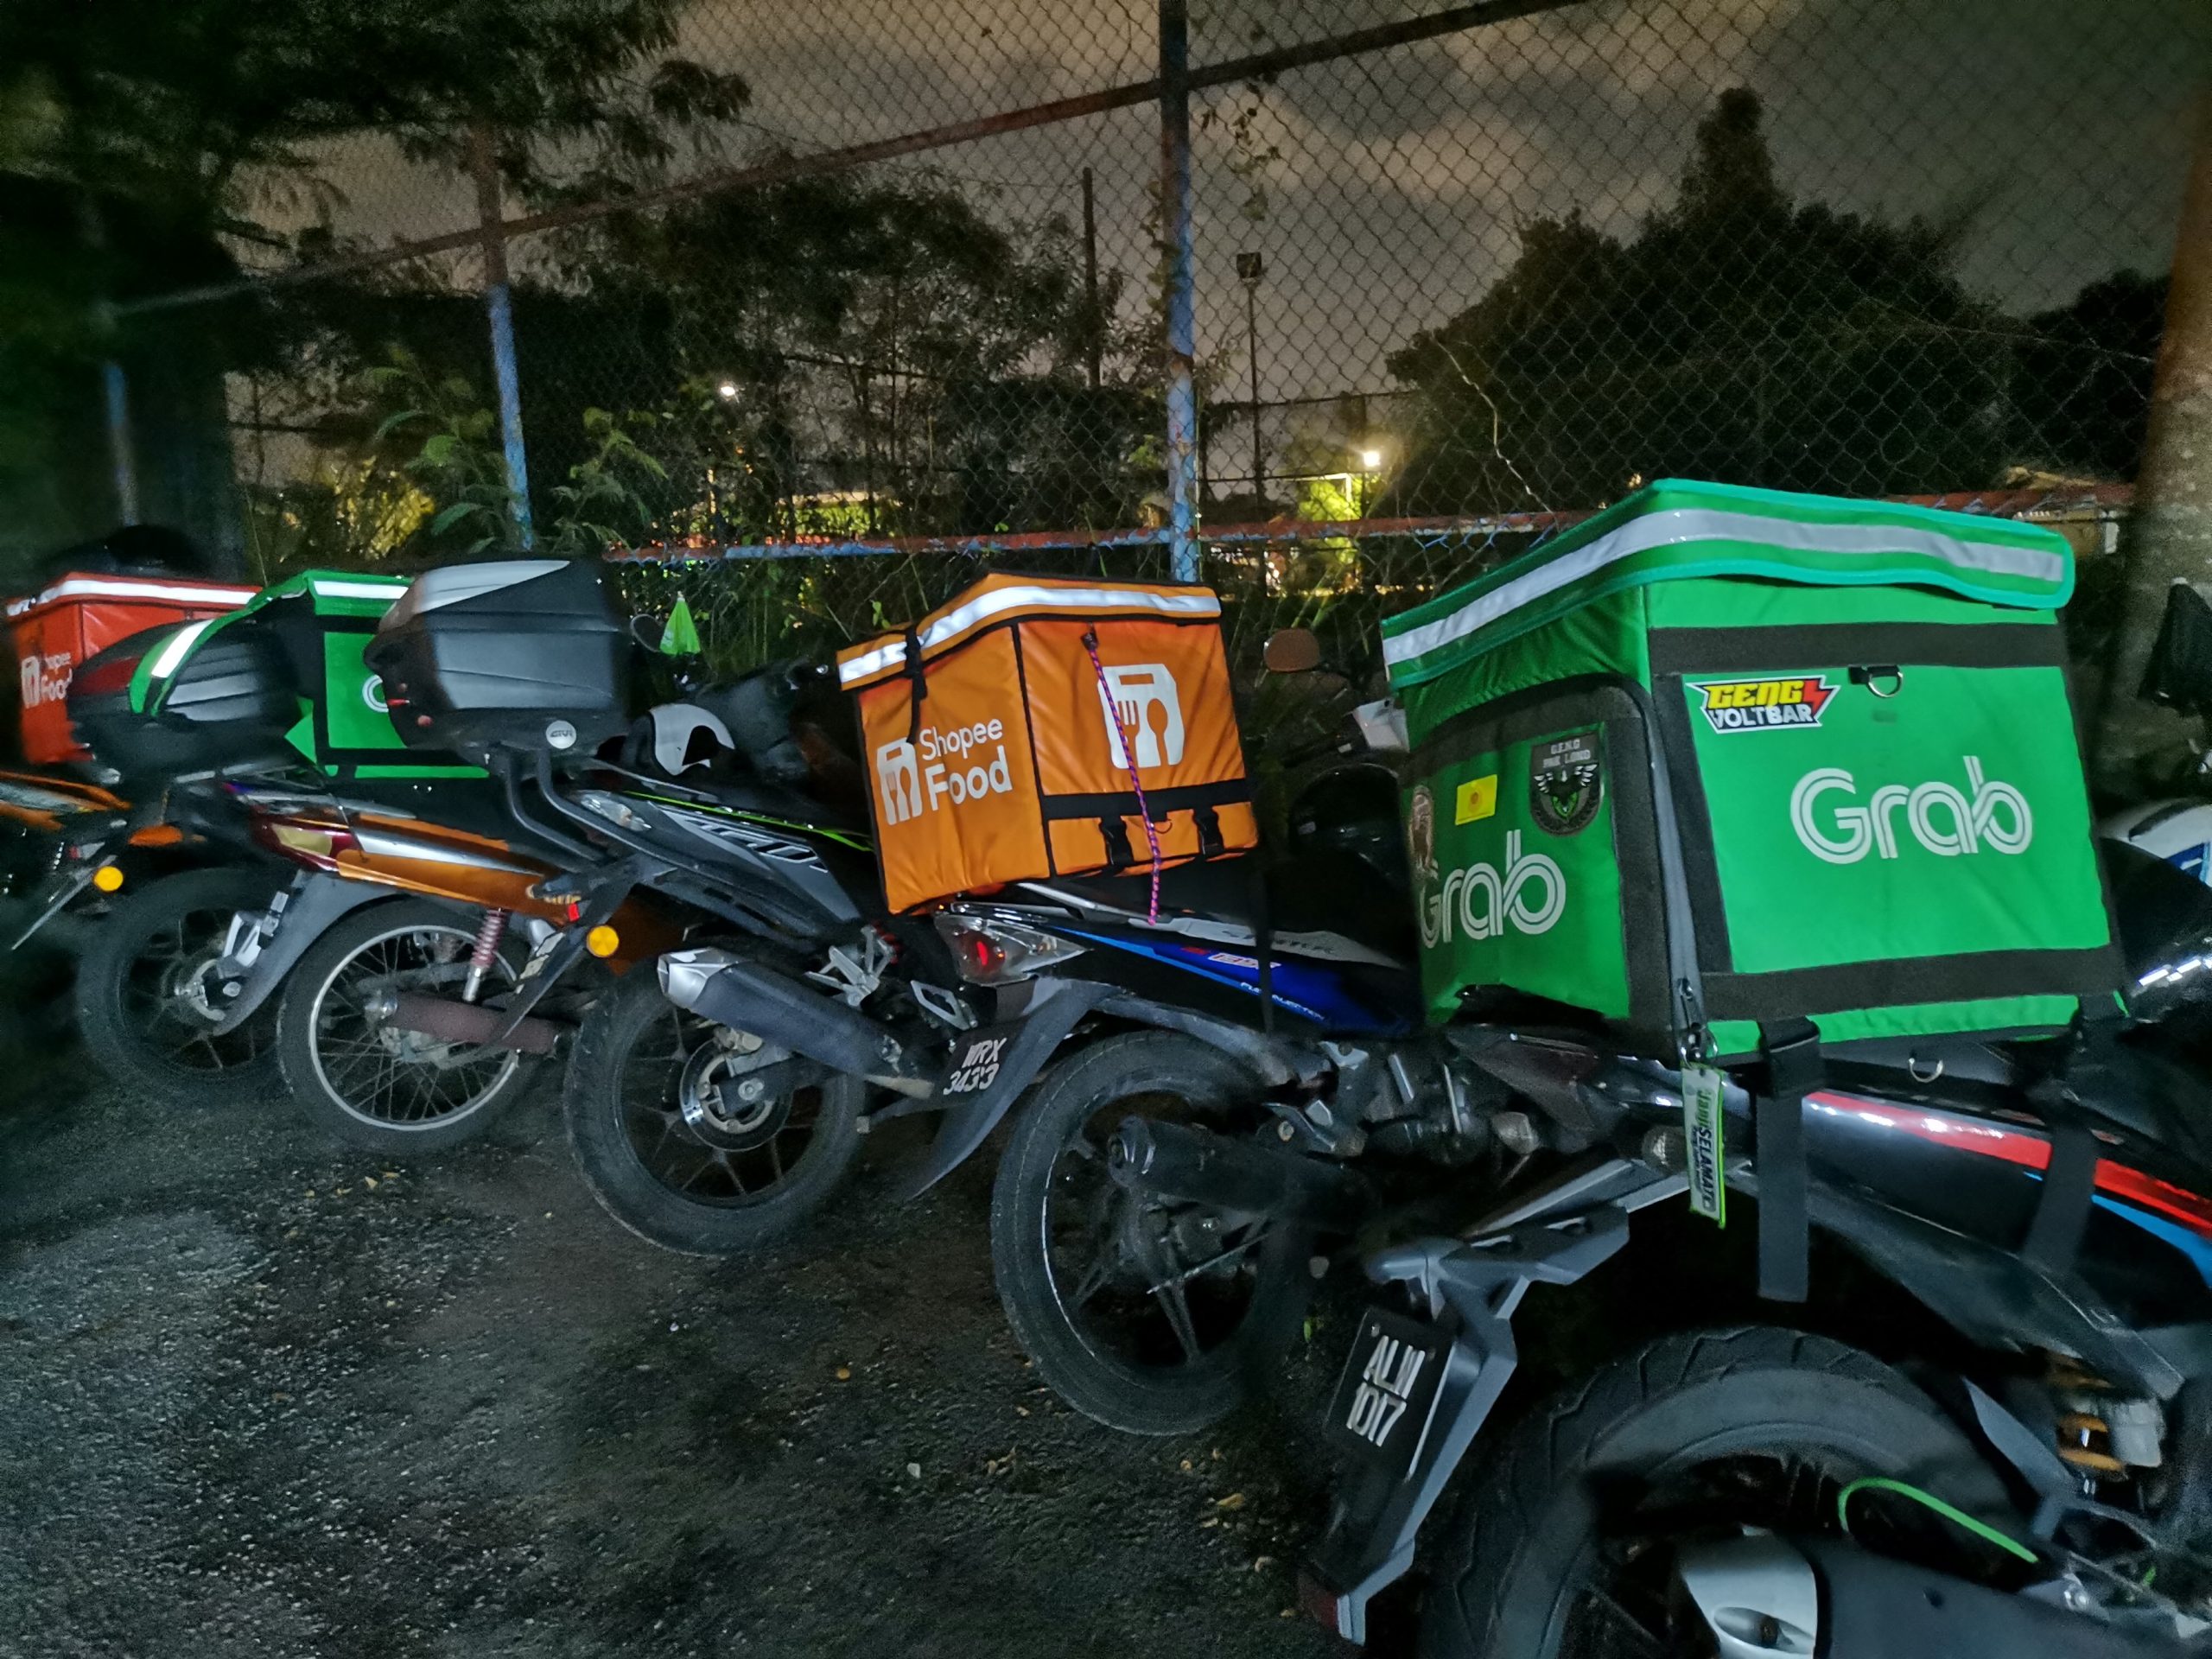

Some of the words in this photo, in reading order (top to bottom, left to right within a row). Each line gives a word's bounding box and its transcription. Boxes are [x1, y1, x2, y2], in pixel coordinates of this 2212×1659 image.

[1703, 680, 1804, 709] GENG
[1707, 703, 1814, 728] VOLTBAR
[919, 718, 1003, 760] Shopee
[925, 745, 1013, 811] Food
[1789, 755, 2032, 864] Grab
[1420, 830, 1567, 948] Grab
[1346, 1382, 1408, 1447] 1017
